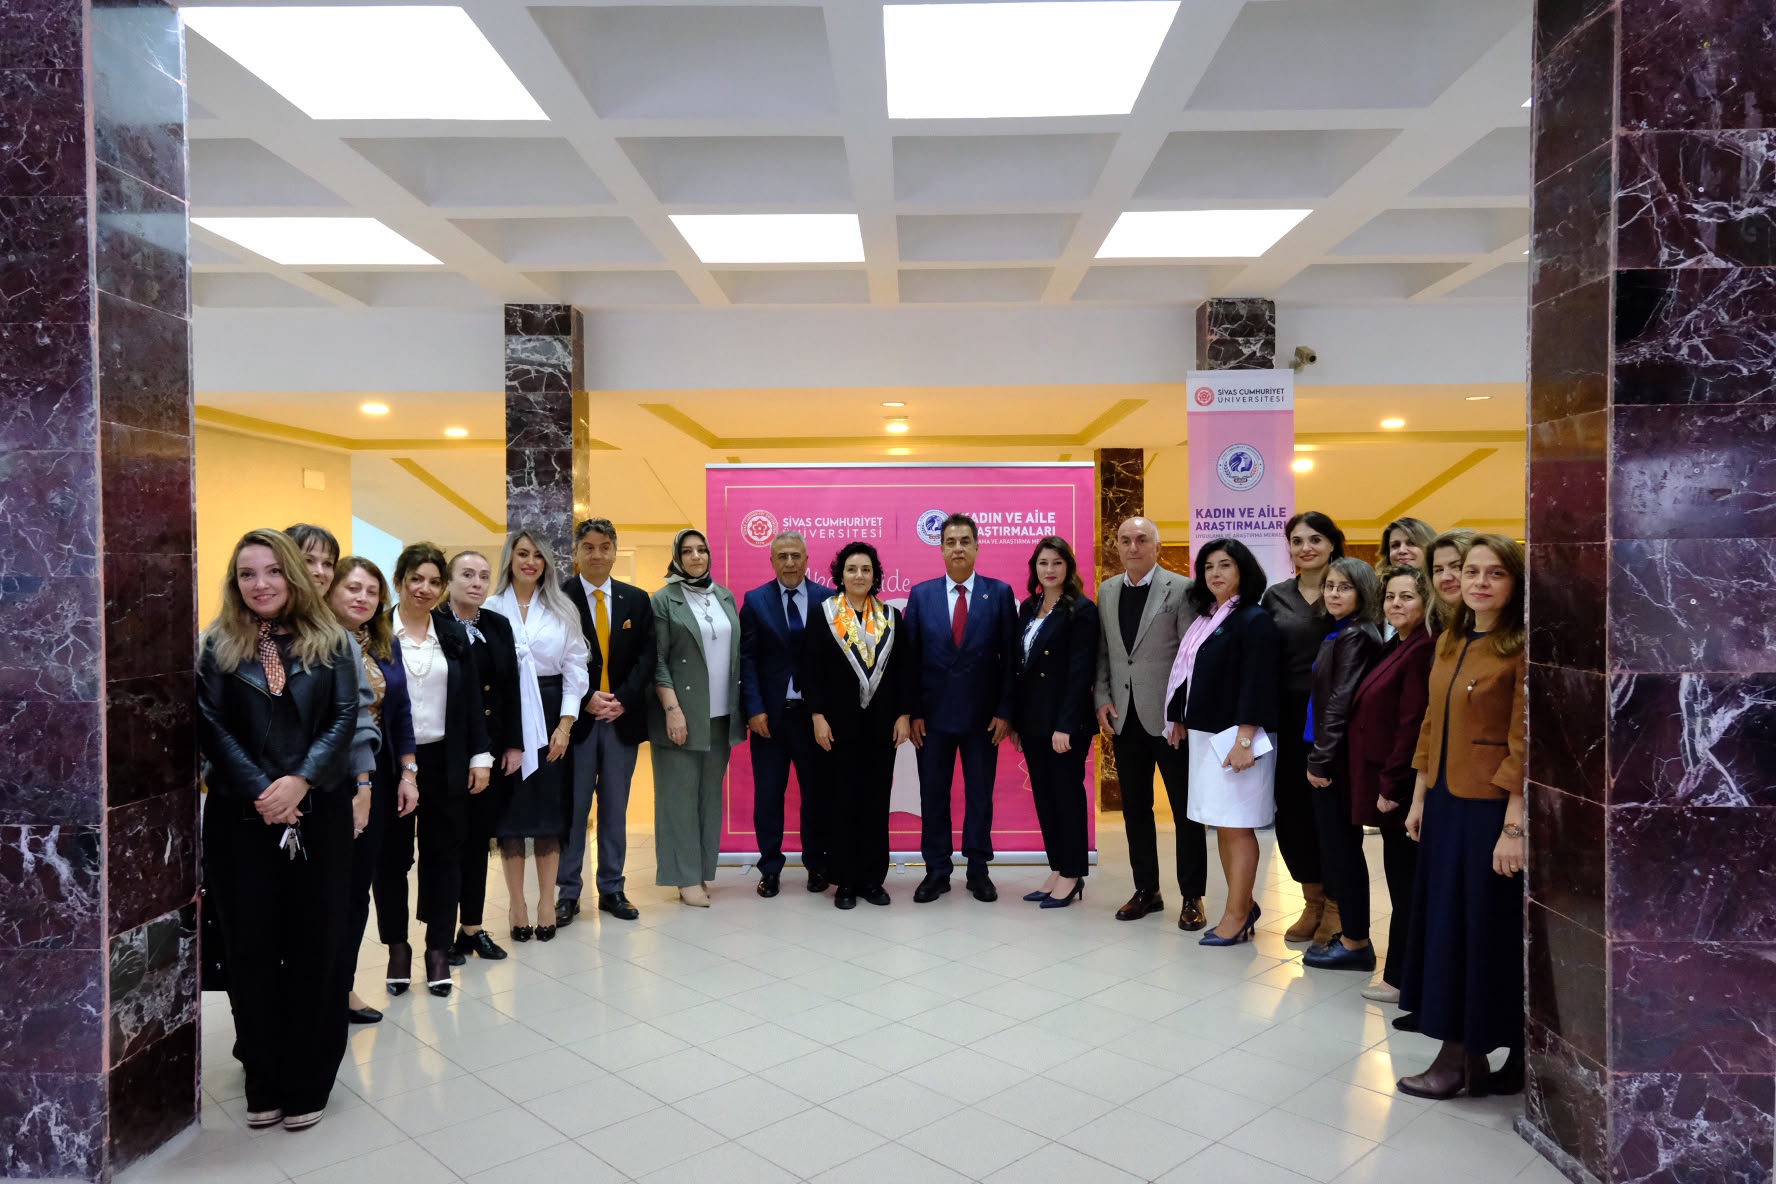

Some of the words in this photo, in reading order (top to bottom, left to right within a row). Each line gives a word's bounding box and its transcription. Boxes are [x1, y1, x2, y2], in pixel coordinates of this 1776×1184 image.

[1217, 387, 1238, 395] SİVAS
[1239, 387, 1285, 395] CUMHURİYET
[960, 511, 1001, 524] ADIN
[1005, 512, 1023, 524] VE
[1025, 509, 1056, 524] AİLE
[1195, 508, 1235, 519] KADIN
[1239, 507, 1255, 518] VE
[1258, 504, 1287, 518] AİLE
[782, 515, 812, 527] SİVAS
[814, 515, 884, 527] CUMHURİYET
[1195, 520, 1287, 531] ARAŞTIRMALARI
[783, 527, 883, 539] İVERSİTESİ
[976, 526, 1056, 538] AŞTIRMALARI
